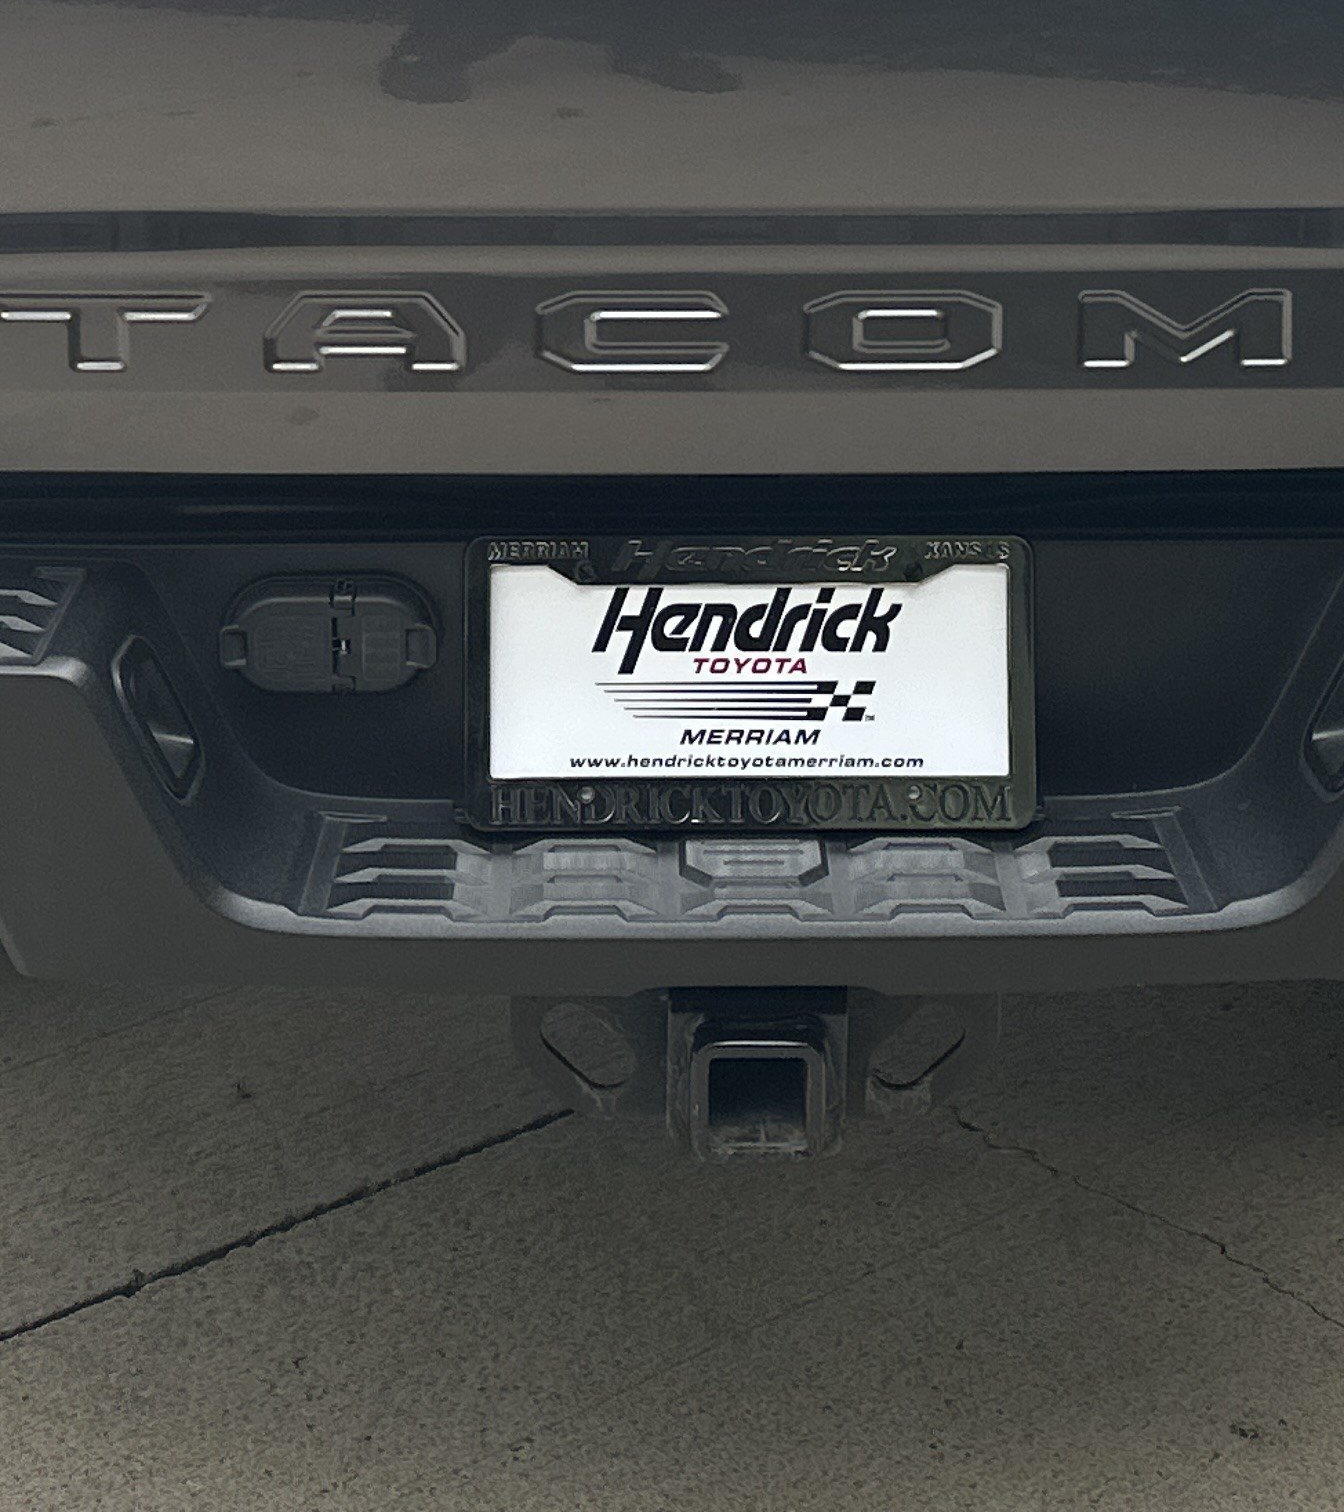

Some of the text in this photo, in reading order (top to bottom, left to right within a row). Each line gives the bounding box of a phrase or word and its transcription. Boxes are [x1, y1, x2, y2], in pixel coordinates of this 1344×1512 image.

[488, 541, 590, 561] MERRIAM
[611, 540, 896, 580] Hendrick
[924, 541, 1010, 561] KANSAS
[591, 587, 903, 675] Hendrick
[693, 658, 808, 674] TOYOTA
[679, 729, 820, 745] MERRIAM
[570, 754, 924, 771] www.hendricktoyotamerriam.com
[489, 783, 1013, 825] HENDRICKTOYOTA.COM
